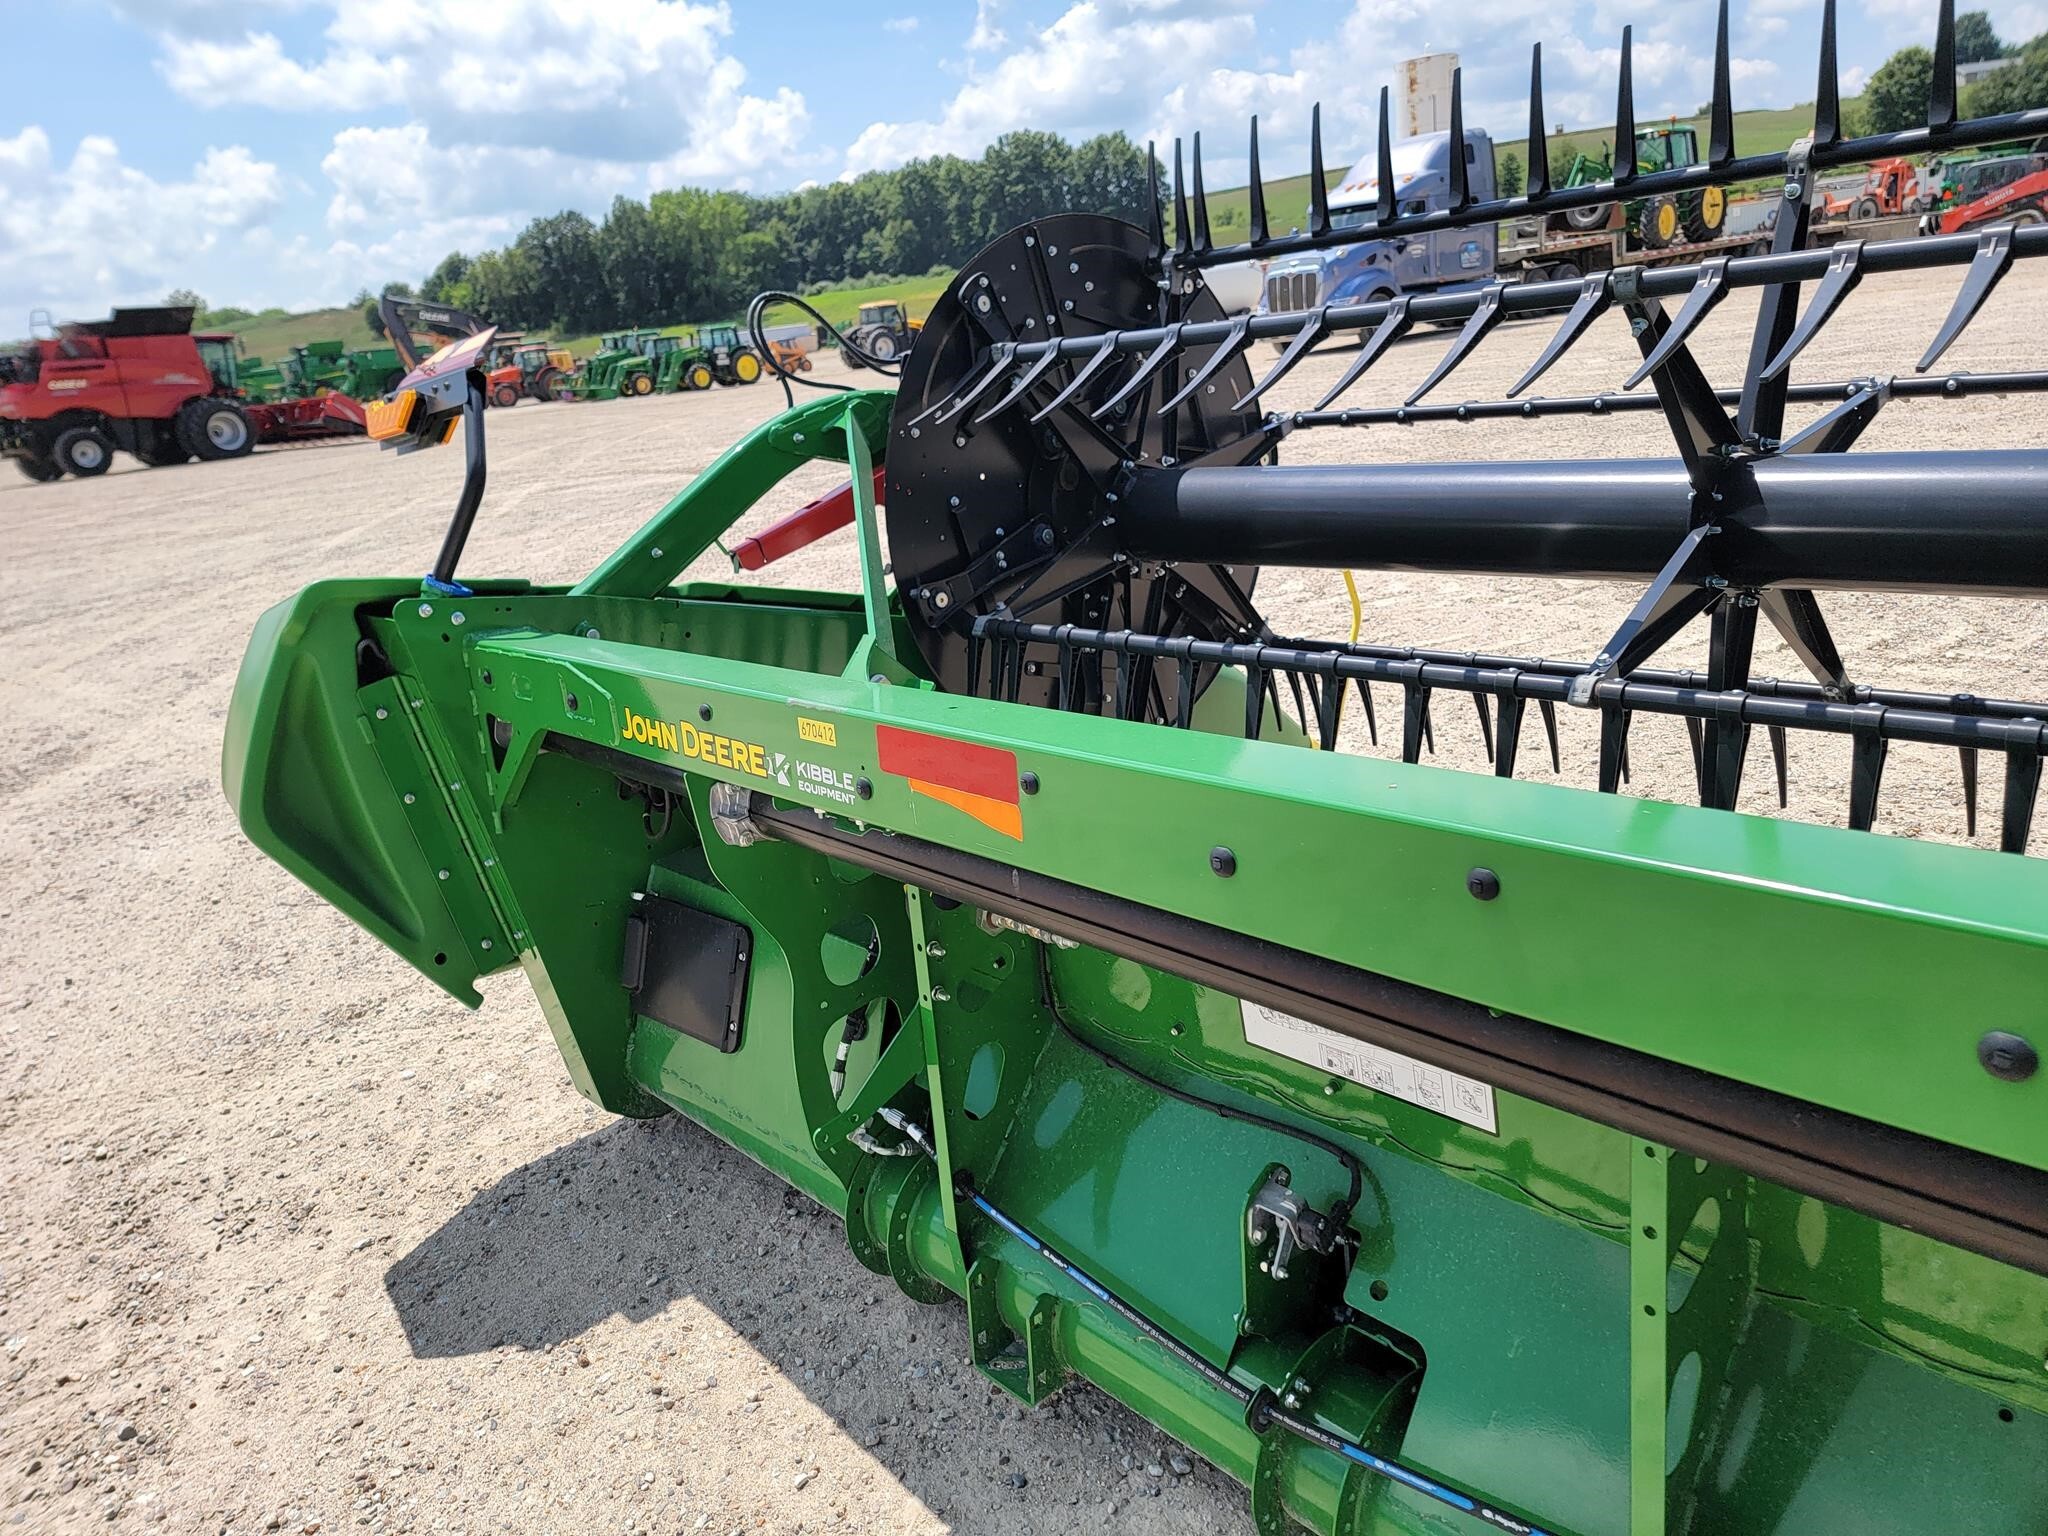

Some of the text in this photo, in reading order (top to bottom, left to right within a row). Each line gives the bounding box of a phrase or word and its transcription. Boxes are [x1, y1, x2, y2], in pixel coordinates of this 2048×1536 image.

[622, 706, 768, 778] JOHN DEERE
[801, 722, 834, 742] 670412
[796, 760, 855, 791] KIBBLE
[798, 780, 855, 805] EQUIPMENT
